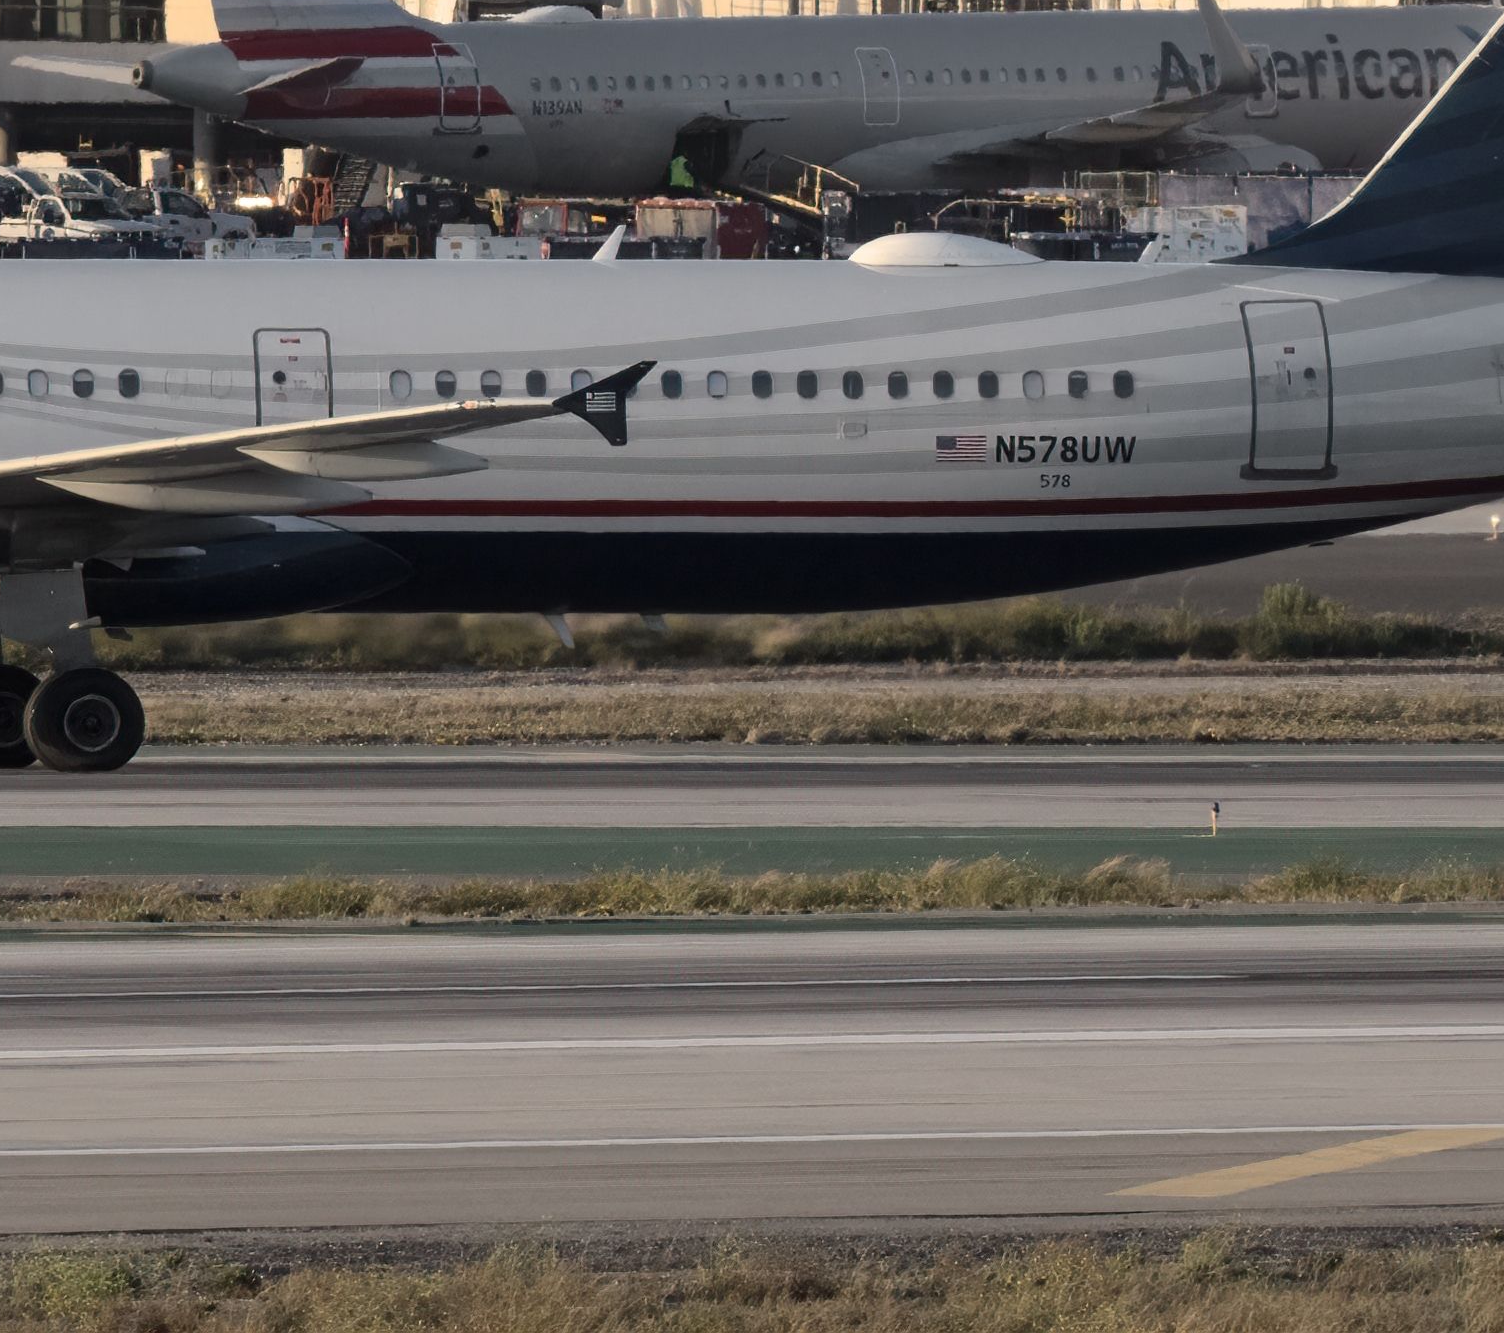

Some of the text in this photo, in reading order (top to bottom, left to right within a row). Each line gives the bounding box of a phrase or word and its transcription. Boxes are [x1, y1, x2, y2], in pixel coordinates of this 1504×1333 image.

[1152, 33, 1459, 101] Aerican
[532, 99, 583, 116] N139AN
[995, 435, 1136, 464] N578UW
[1040, 473, 1071, 488] 578
